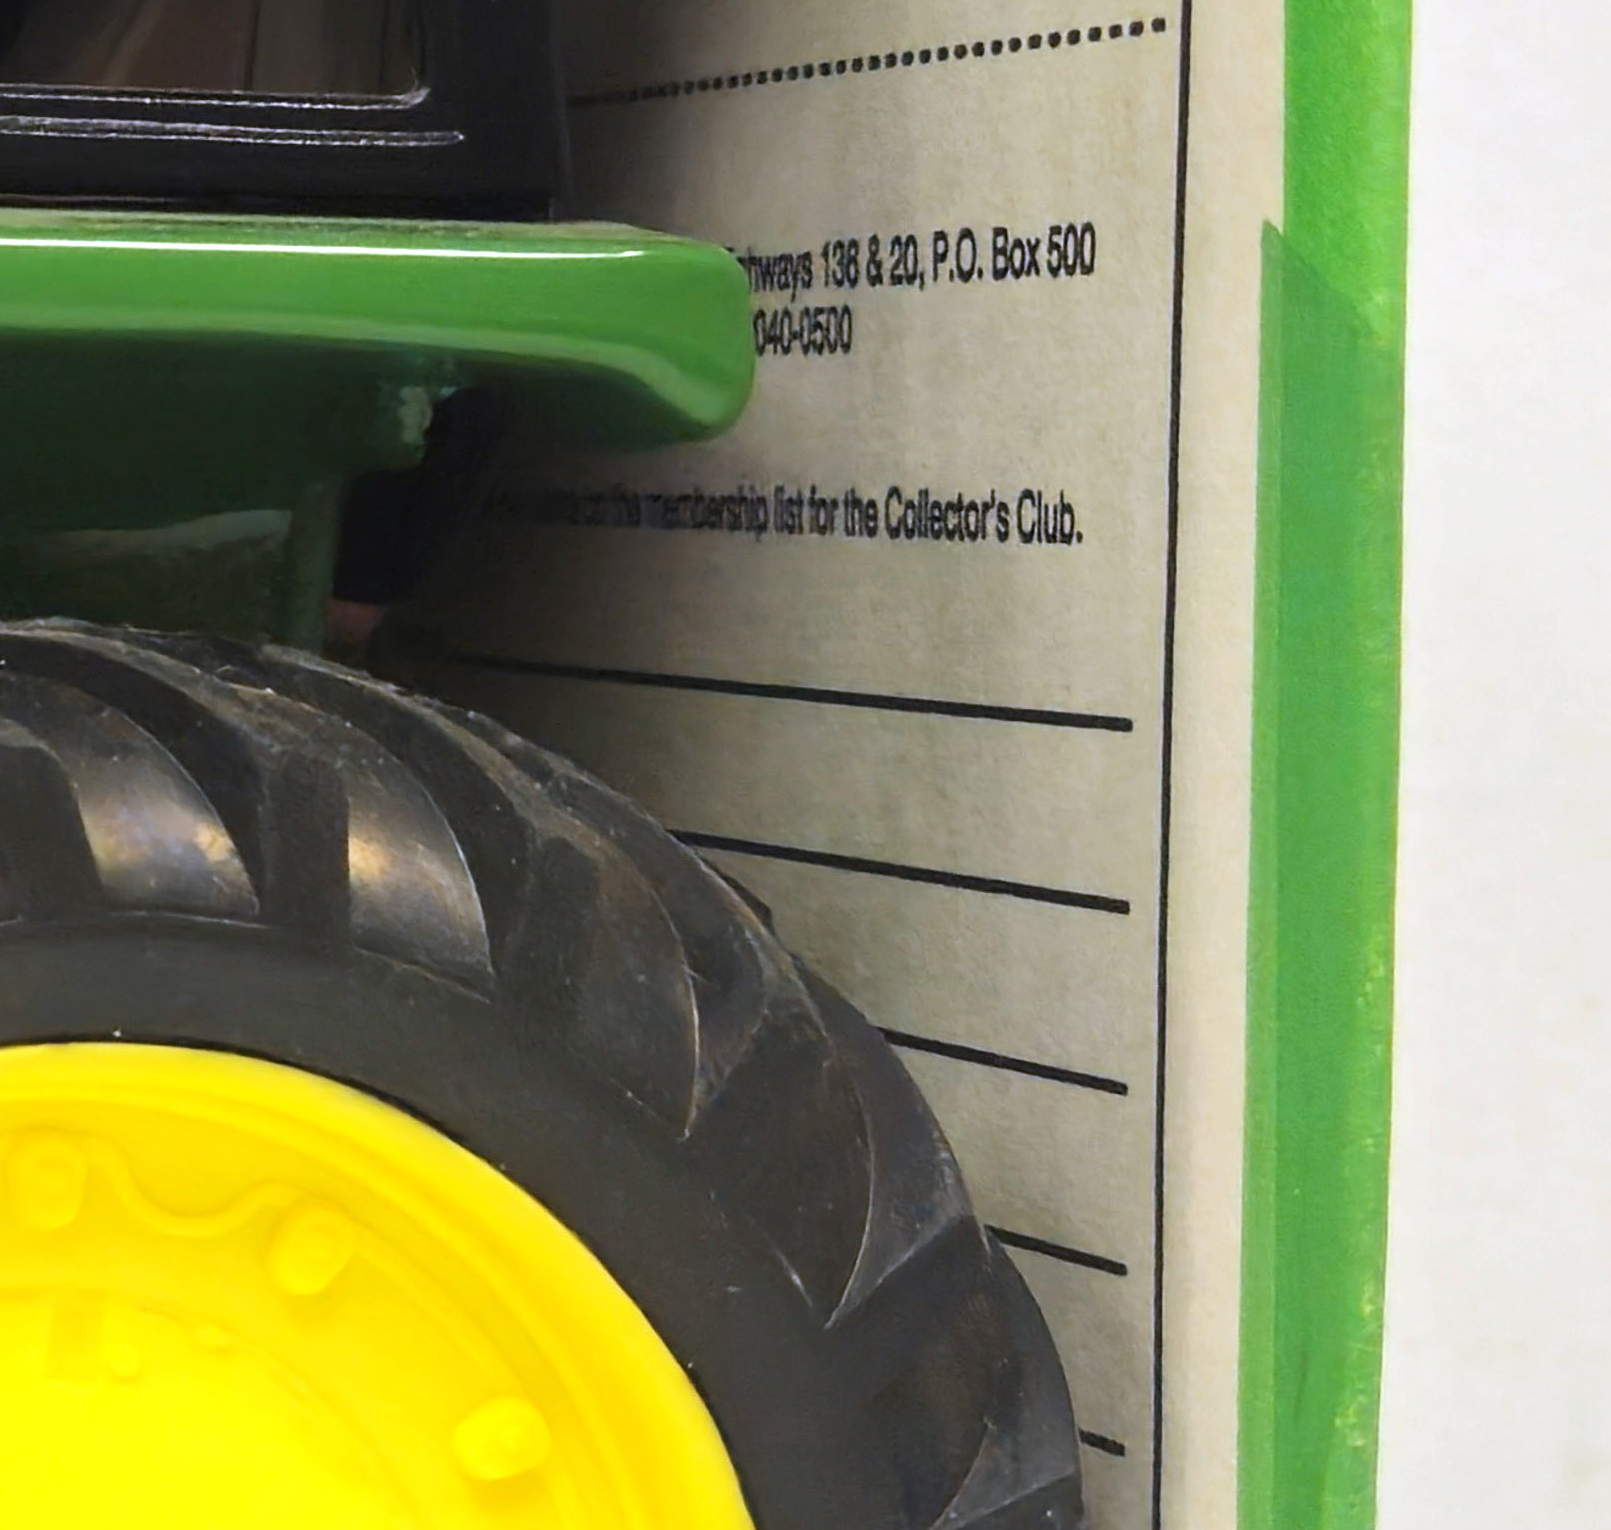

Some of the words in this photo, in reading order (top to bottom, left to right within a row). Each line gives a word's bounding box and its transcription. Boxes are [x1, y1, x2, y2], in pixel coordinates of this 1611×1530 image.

[867, 234, 884, 287] &
[889, 234, 924, 291] 20,
[933, 227, 983, 283] P.O.
[992, 226, 1040, 280] Box
[1047, 222, 1096, 278] 500
[774, 484, 803, 536] list
[809, 484, 838, 537] for
[844, 487, 878, 539] the
[885, 485, 1010, 543] Collector's
[1017, 488, 1083, 546] Club.
